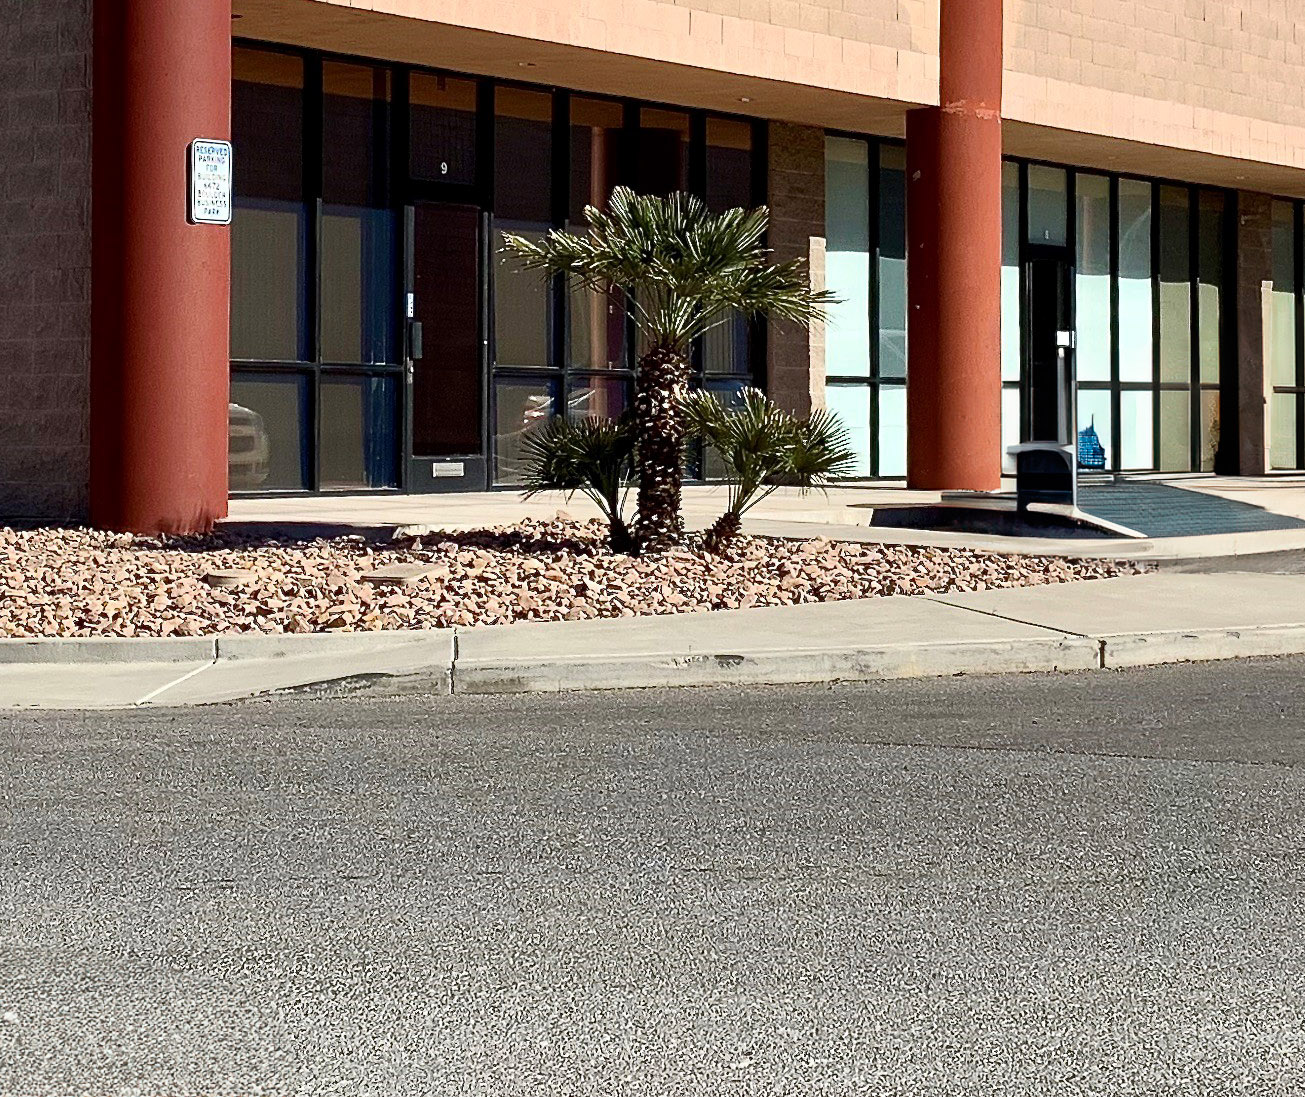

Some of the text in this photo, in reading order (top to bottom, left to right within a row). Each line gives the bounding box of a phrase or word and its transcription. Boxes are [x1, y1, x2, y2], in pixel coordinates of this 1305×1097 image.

[196, 145, 227, 156] RESERVED
[198, 155, 225, 164] PARKING
[206, 164, 217, 172] FOR
[441, 162, 448, 174] 9
